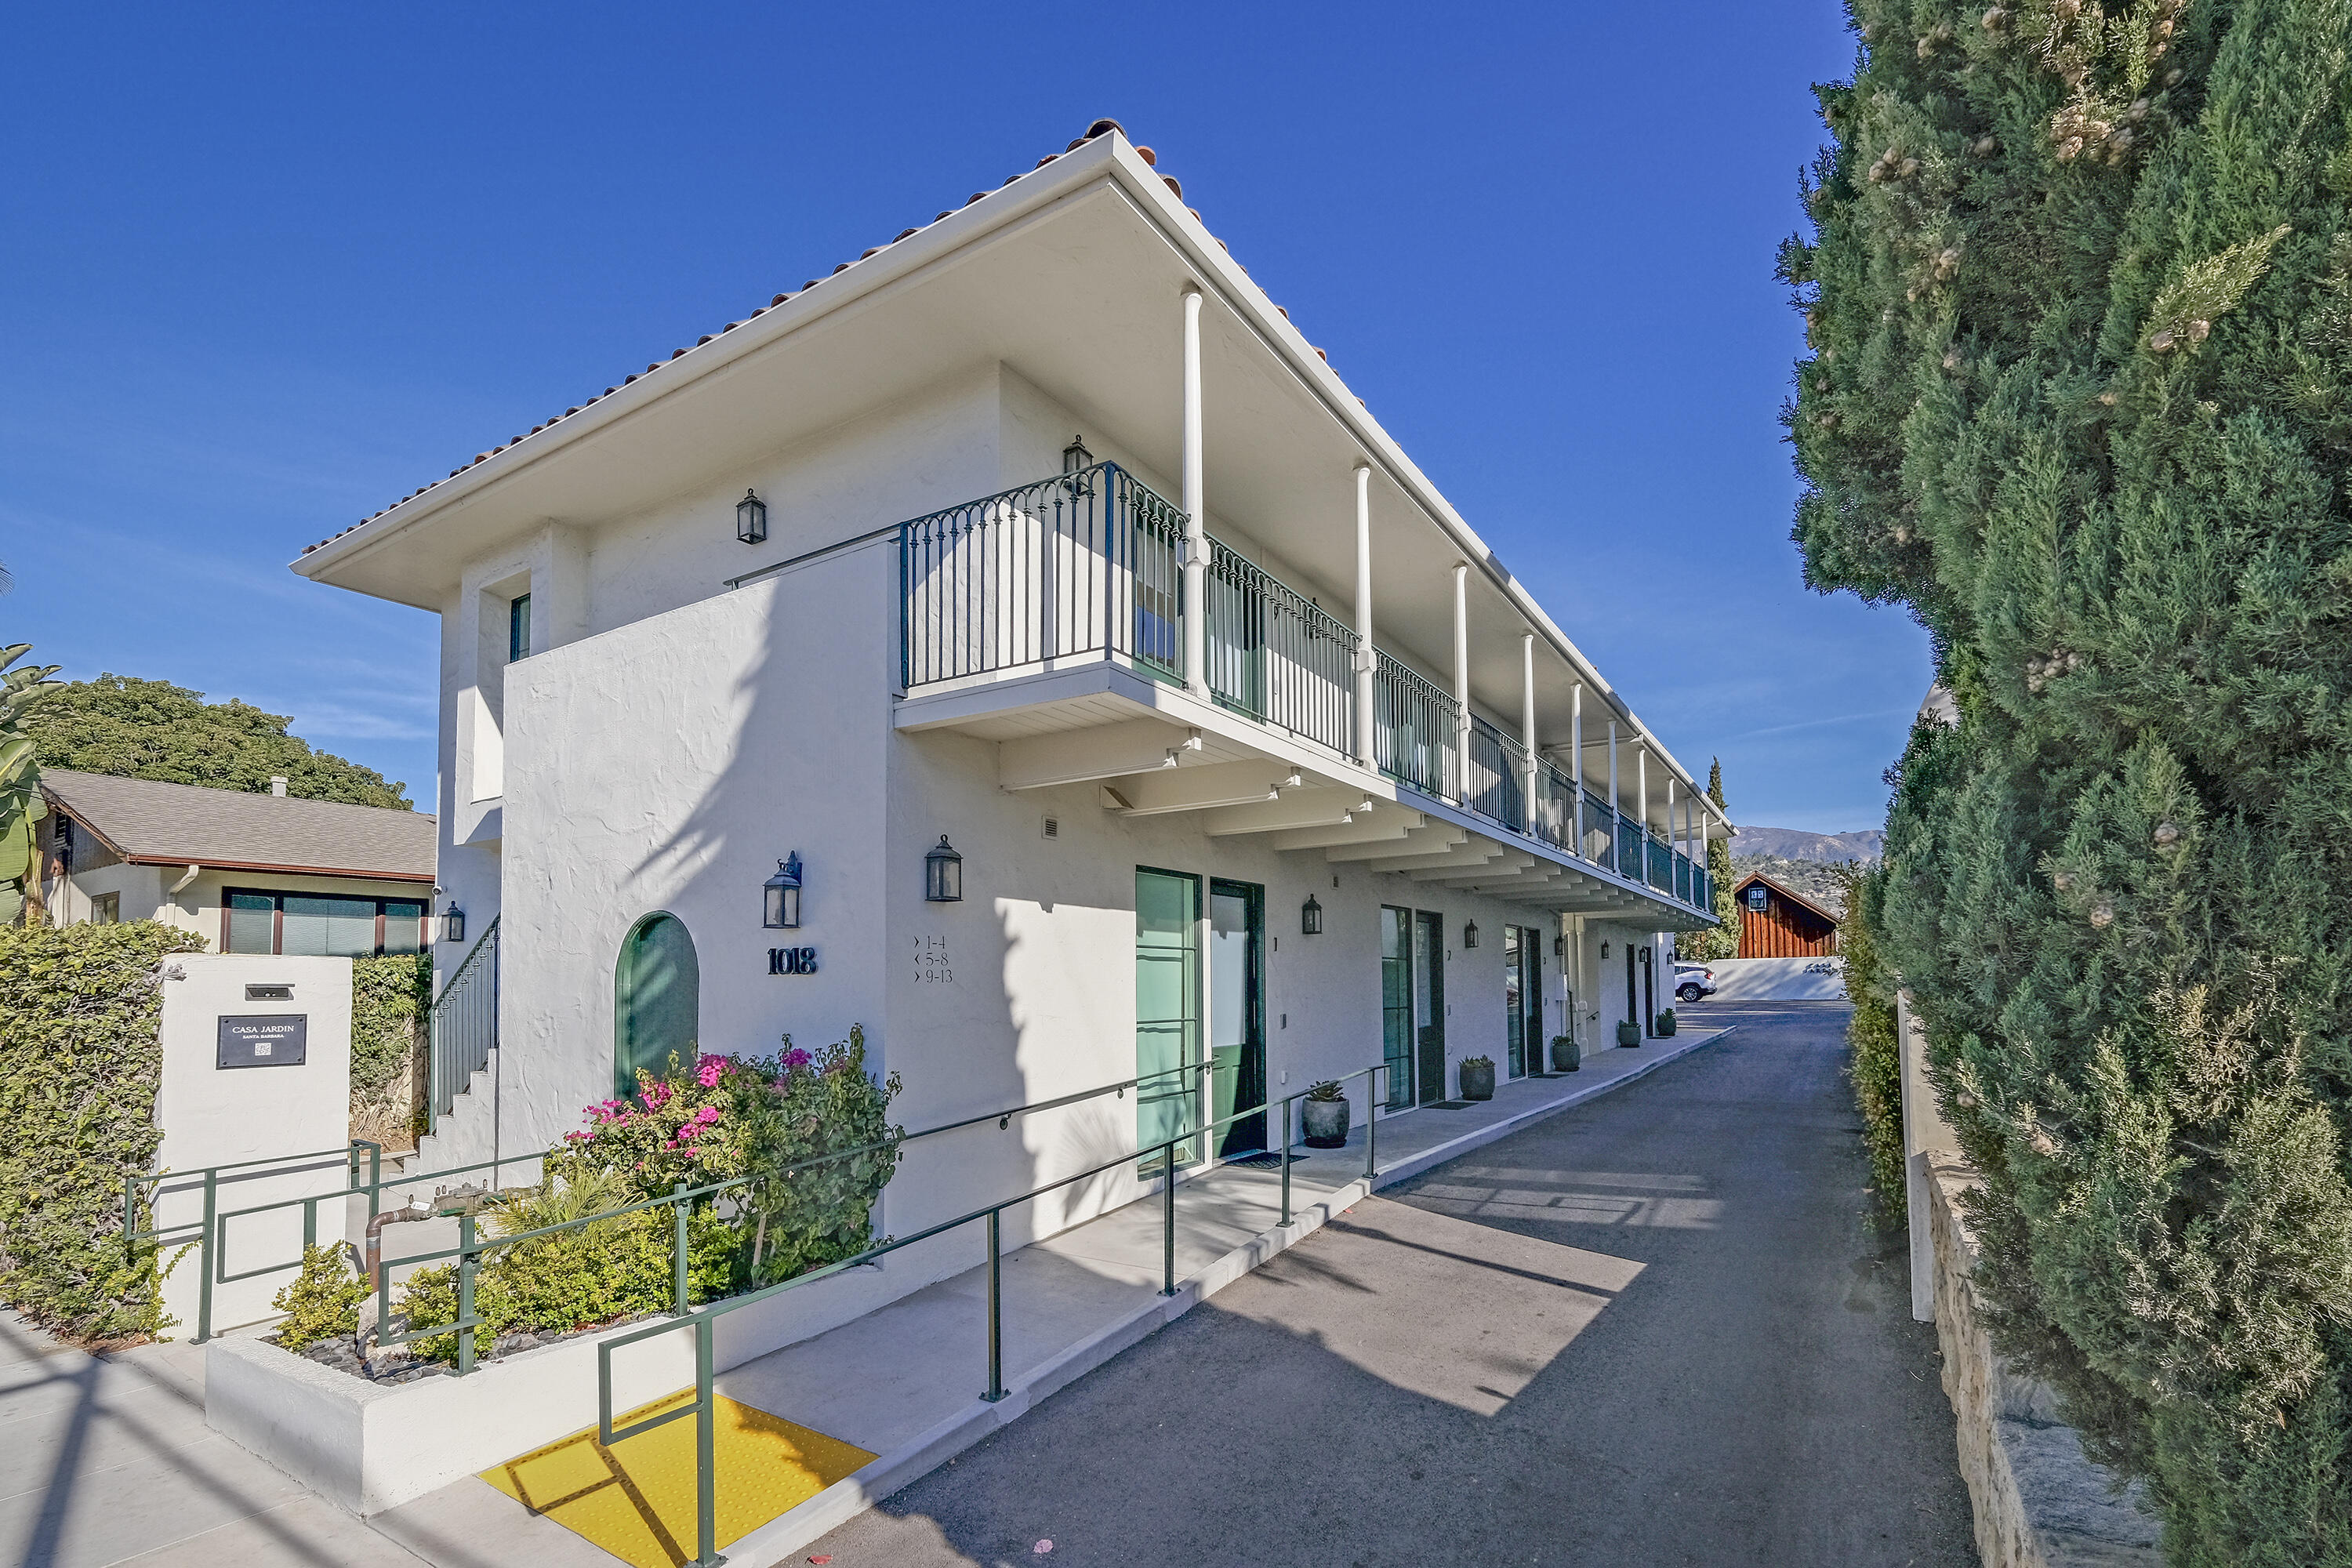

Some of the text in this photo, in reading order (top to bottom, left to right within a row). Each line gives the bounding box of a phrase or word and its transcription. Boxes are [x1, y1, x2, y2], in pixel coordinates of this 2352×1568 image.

[927, 935, 946, 949] 1-4
[768, 947, 817, 975] 1018
[926, 952, 949, 967] 5-8
[926, 969, 953, 983] 9-13
[260, 1025, 295, 1033] JARDIN
